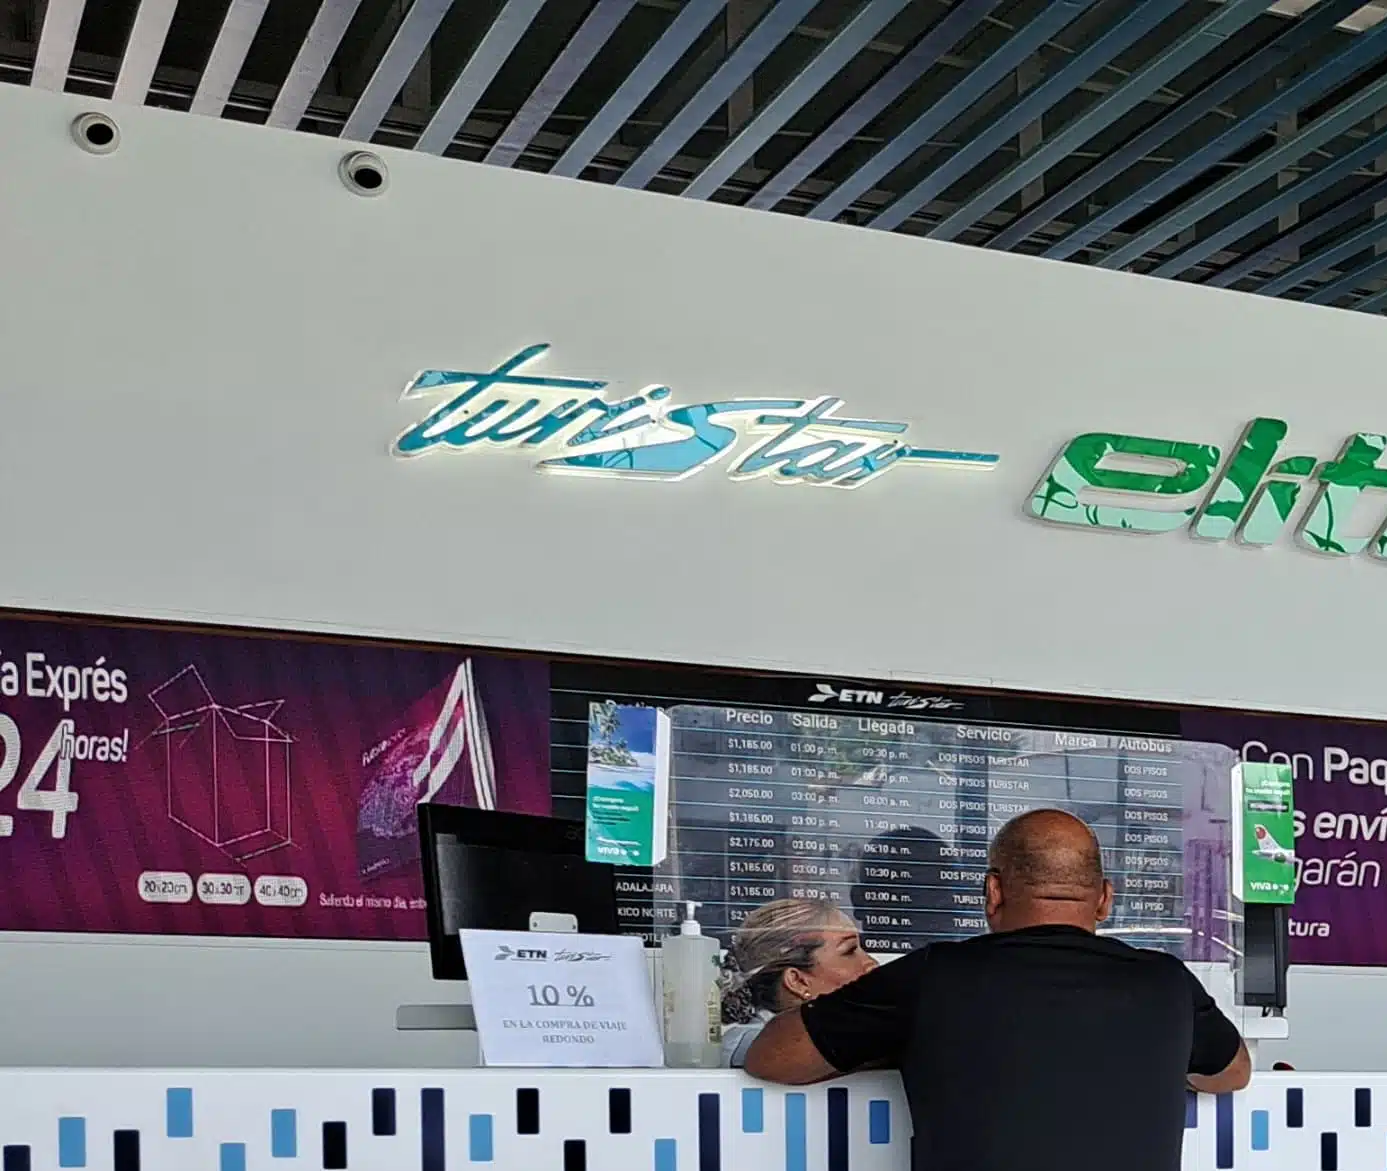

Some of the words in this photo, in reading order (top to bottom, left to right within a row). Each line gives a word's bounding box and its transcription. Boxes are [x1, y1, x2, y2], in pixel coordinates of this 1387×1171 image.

[26, 652, 128, 712] Exprés
[839, 688, 885, 705] ETN
[726, 708, 773, 725] Precio
[792, 713, 838, 729] Salida
[858, 719, 915, 736] Llegada
[956, 726, 1012, 741] Servicio
[61, 722, 129, 763] horas!
[1055, 732, 1097, 748] Marca
[938, 752, 957, 763] DOS
[959, 753, 986, 765] PISOS
[959, 777, 986, 788] PISOS
[939, 799, 958, 810] DOS
[960, 800, 986, 812] PISOS
[940, 823, 958, 833] DOS
[960, 824, 986, 835] PISOS
[940, 847, 958, 857] DOS
[960, 847, 987, 858] PISOS
[940, 870, 959, 880] DOS
[952, 895, 986, 905] TURIST
[953, 918, 987, 928] TURIST
[1287, 918, 1330, 937] tura
[516, 949, 548, 959] ETN
[527, 984, 560, 1006] 10
[567, 984, 595, 1007] %
[503, 1019, 518, 1029] EN
[520, 1020, 535, 1029] LA
[536, 1020, 581, 1030] COMPRA
[583, 1021, 598, 1030] DE
[600, 1021, 627, 1031] VIAJE
[542, 1034, 595, 1044] REDONDO
